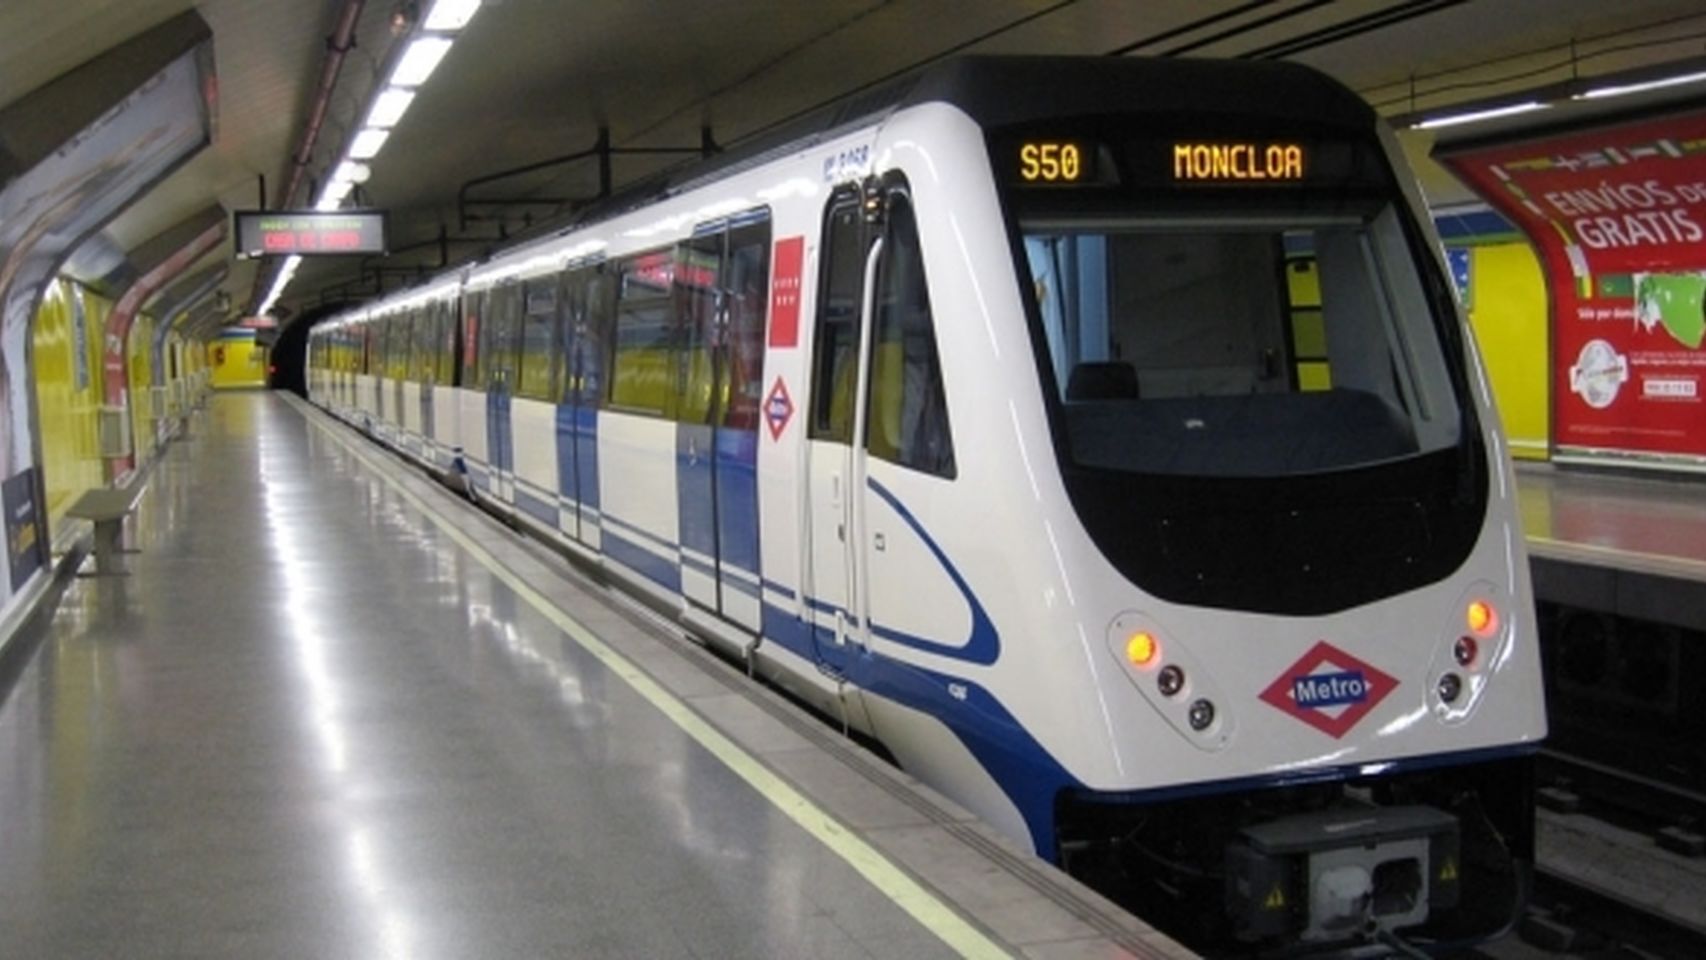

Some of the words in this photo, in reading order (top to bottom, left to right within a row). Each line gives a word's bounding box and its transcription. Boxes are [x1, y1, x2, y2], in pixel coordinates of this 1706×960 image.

[1020, 144, 1079, 180] S50
[1174, 144, 1302, 179] MONCLOA
[1543, 180, 1678, 216] ENVÍOS
[1573, 208, 1703, 249] GRATIS
[1296, 677, 1363, 702] Metro
